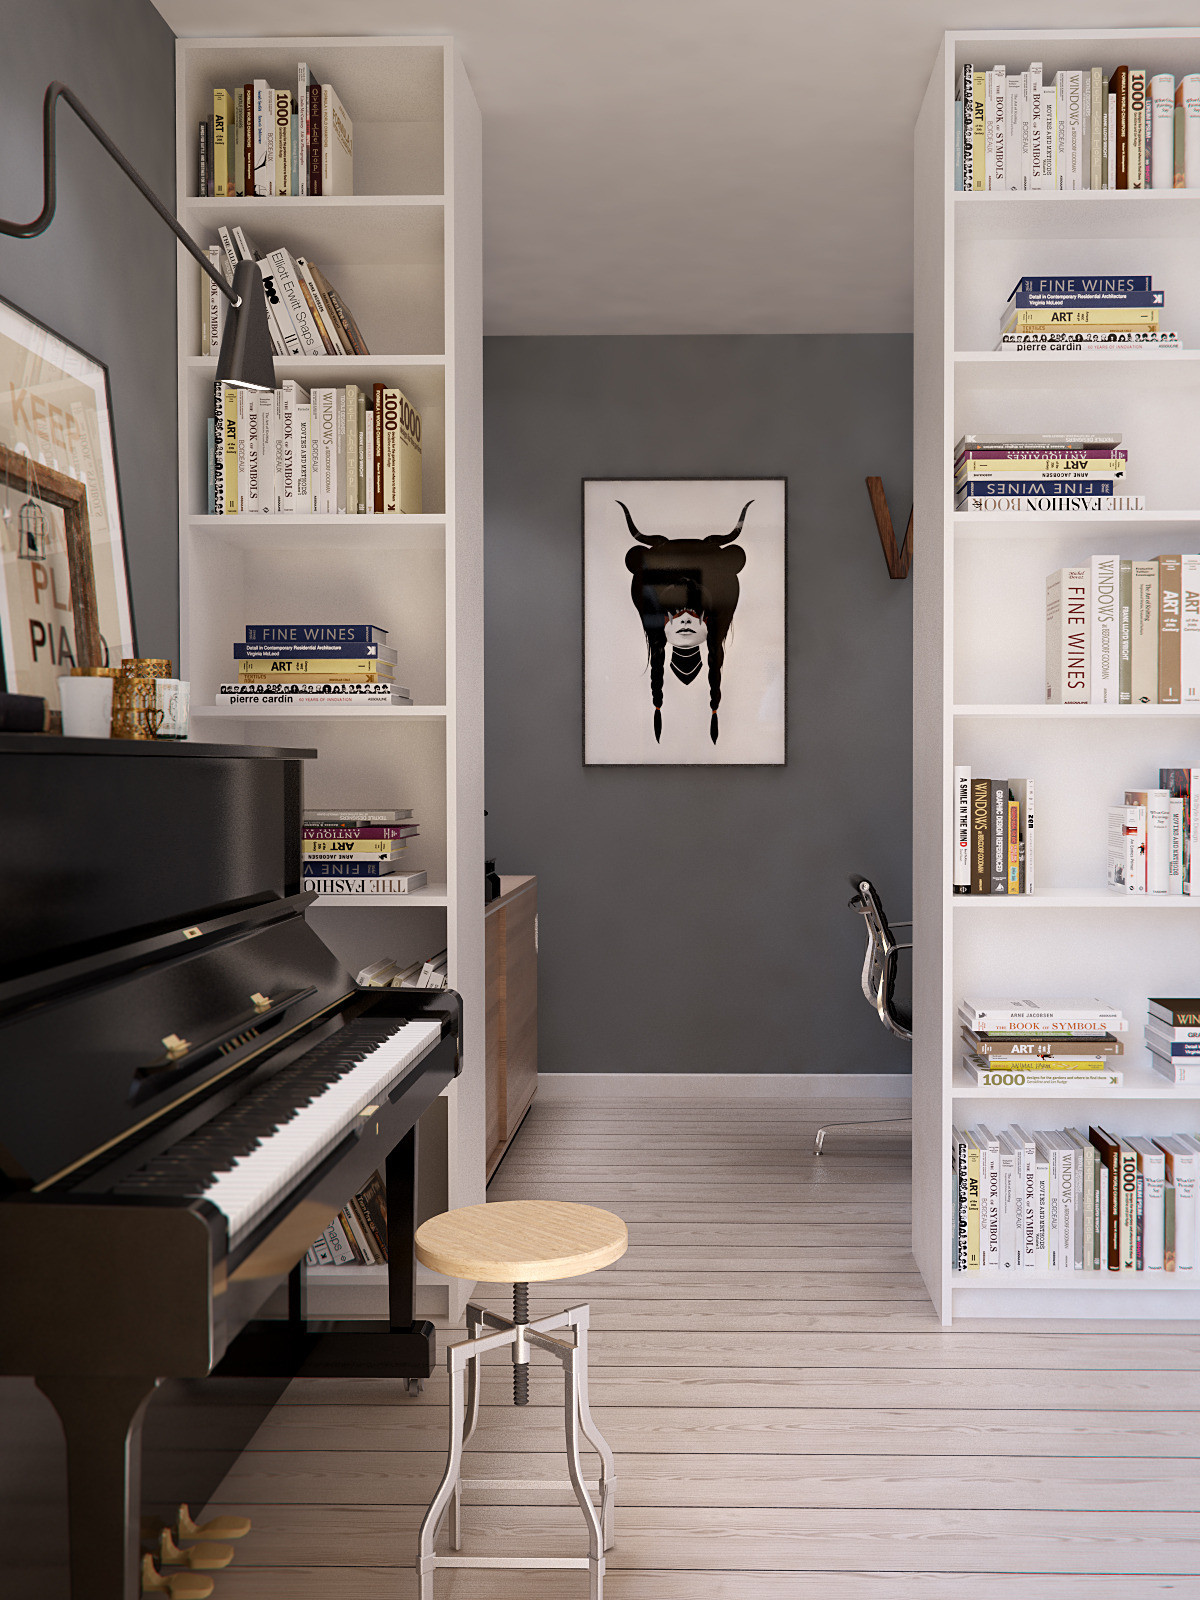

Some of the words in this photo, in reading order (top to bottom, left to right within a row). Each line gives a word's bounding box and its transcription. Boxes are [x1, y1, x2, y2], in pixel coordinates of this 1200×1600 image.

[1070, 74, 1079, 126] WINDOWS
[1131, 74, 1144, 111] 1000
[277, 94, 288, 126] 1000
[975, 102, 983, 121] ART
[216, 115, 224, 132] ART
[222, 234, 231, 246] THE
[1040, 280, 1075, 291] FINE
[1082, 279, 1134, 291] WINES
[272, 252, 290, 280] Elliott
[284, 280, 302, 310] Erwitt
[296, 312, 315, 346] Snaps
[1051, 312, 1073, 322] ART
[1017, 343, 1047, 351] pierre
[1050, 342, 1082, 351] cardin
[9, 380, 81, 452] KEEP
[323, 392, 333, 444] WINDOWS
[385, 393, 397, 430] 1000
[400, 397, 421, 442] 1000
[227, 419, 236, 439] ART
[1064, 461, 1088, 470] ART
[987, 483, 1045, 494] WINES
[1054, 484, 1092, 493] FINE
[973, 498, 1020, 511] BOOK
[1027, 498, 1100, 511] FASHION
[1107, 498, 1143, 511] THE
[1098, 560, 1114, 622] WINDOWS
[1068, 588, 1085, 624] FINE
[1163, 591, 1179, 615] ART
[1185, 591, 1200, 614] ART
[263, 629, 297, 640] FINE
[304, 628, 355, 640] WINES
[271, 662, 292, 671] ART
[1068, 632, 1085, 688] WINES
[230, 695, 260, 705] pierre
[975, 782, 987, 829] WINDOWS
[330, 842, 354, 851] ART
[322, 864, 360, 875] FINE
[304, 880, 365, 893] FASHIO
[371, 880, 405, 892] THE
[1177, 1015, 1200, 1024] WIN
[1011, 1045, 1034, 1053] ART
[983, 1074, 1025, 1086] 1000
[1062, 1154, 1071, 1203] WINDOWS
[1124, 1157, 1135, 1192] 1000
[970, 1178, 978, 1197] ART
